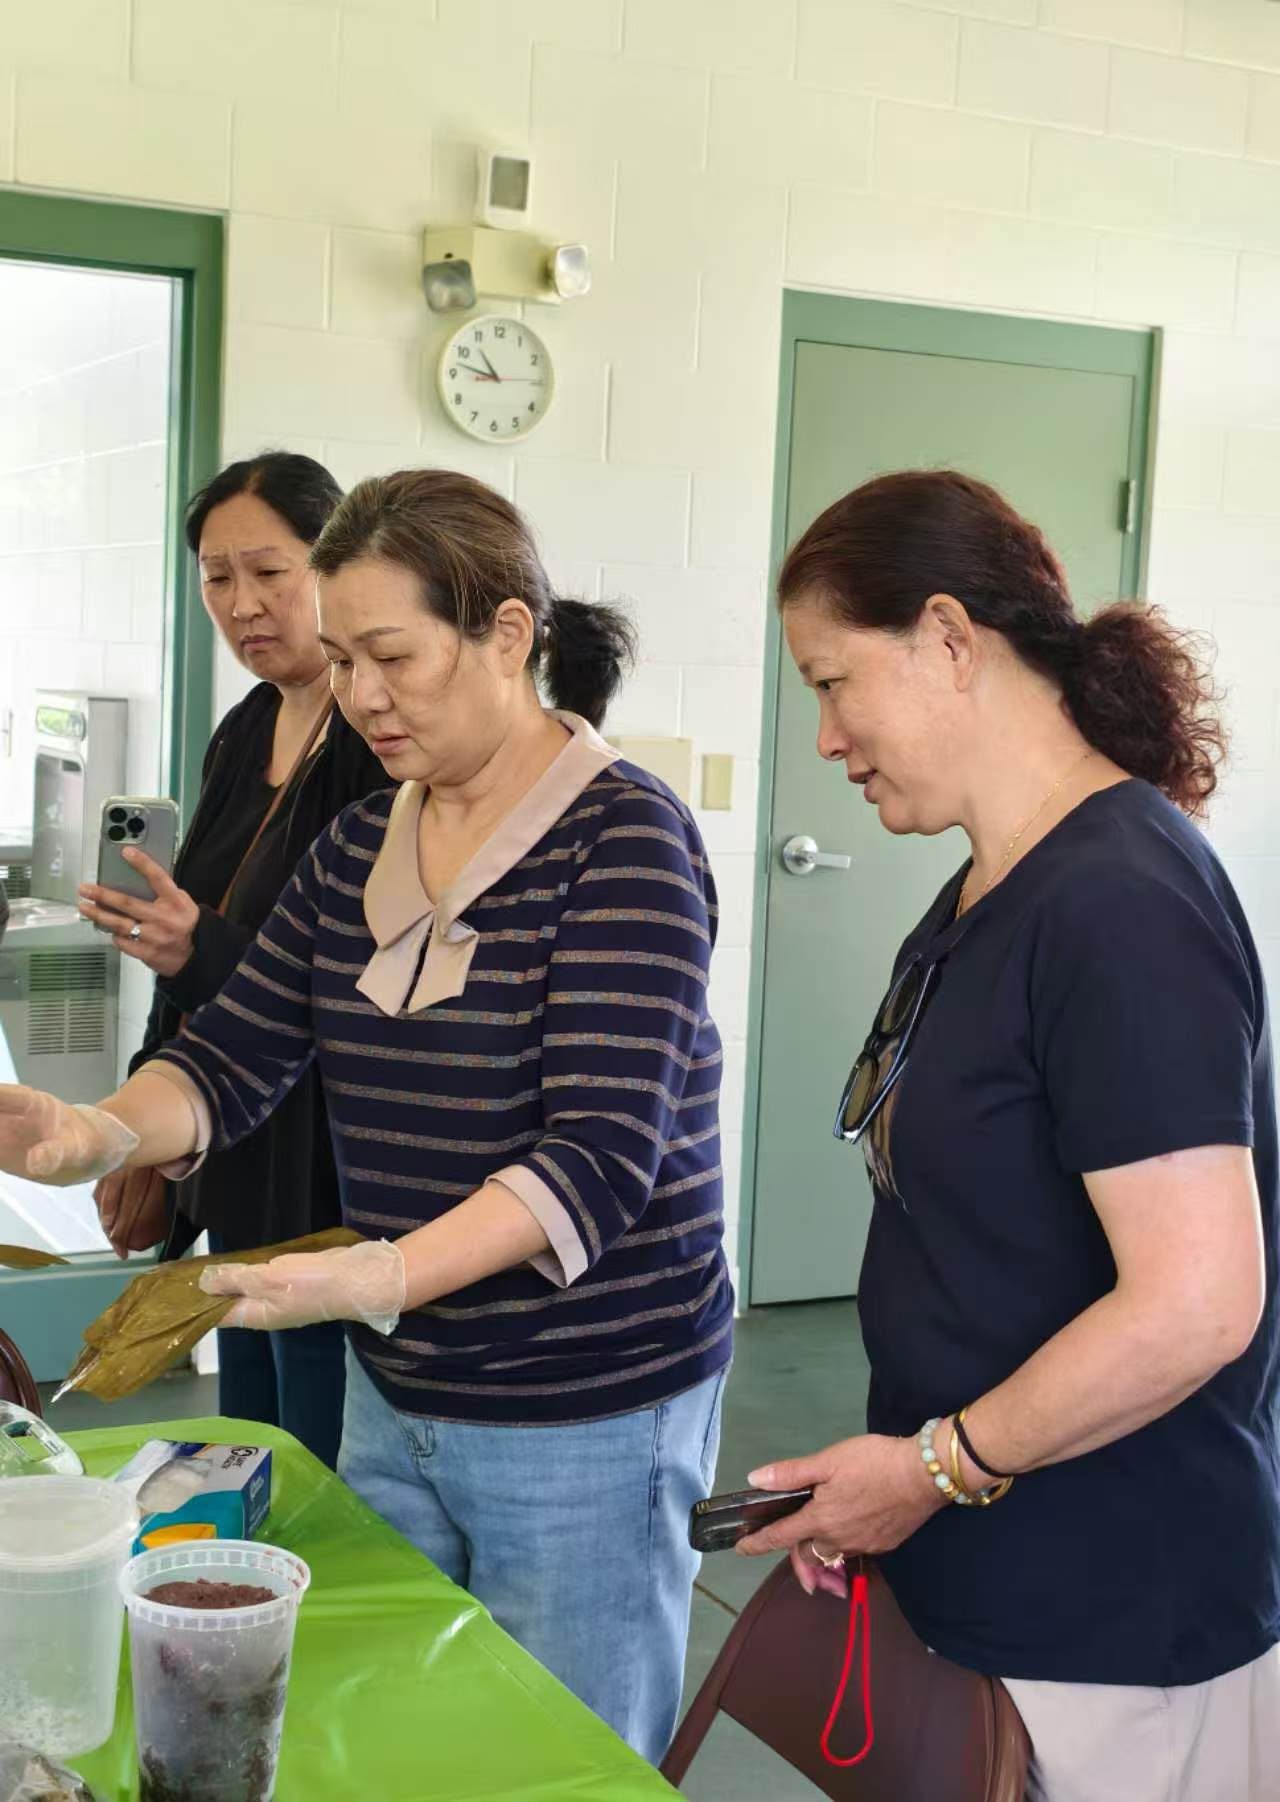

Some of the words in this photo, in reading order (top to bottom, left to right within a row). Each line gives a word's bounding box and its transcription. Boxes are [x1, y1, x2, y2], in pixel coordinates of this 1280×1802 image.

[474, 331, 482, 343] 11
[494, 326, 506, 339] 12
[518, 335, 522, 348] 1
[457, 346, 470, 358] 10
[530, 355, 538, 366] 2
[449, 368, 457, 379] 9
[454, 393, 462, 405] 8
[528, 401, 535, 412] 4
[471, 411, 479, 422] 7
[512, 416, 519, 428] 5
[489, 420, 497, 432] 6
